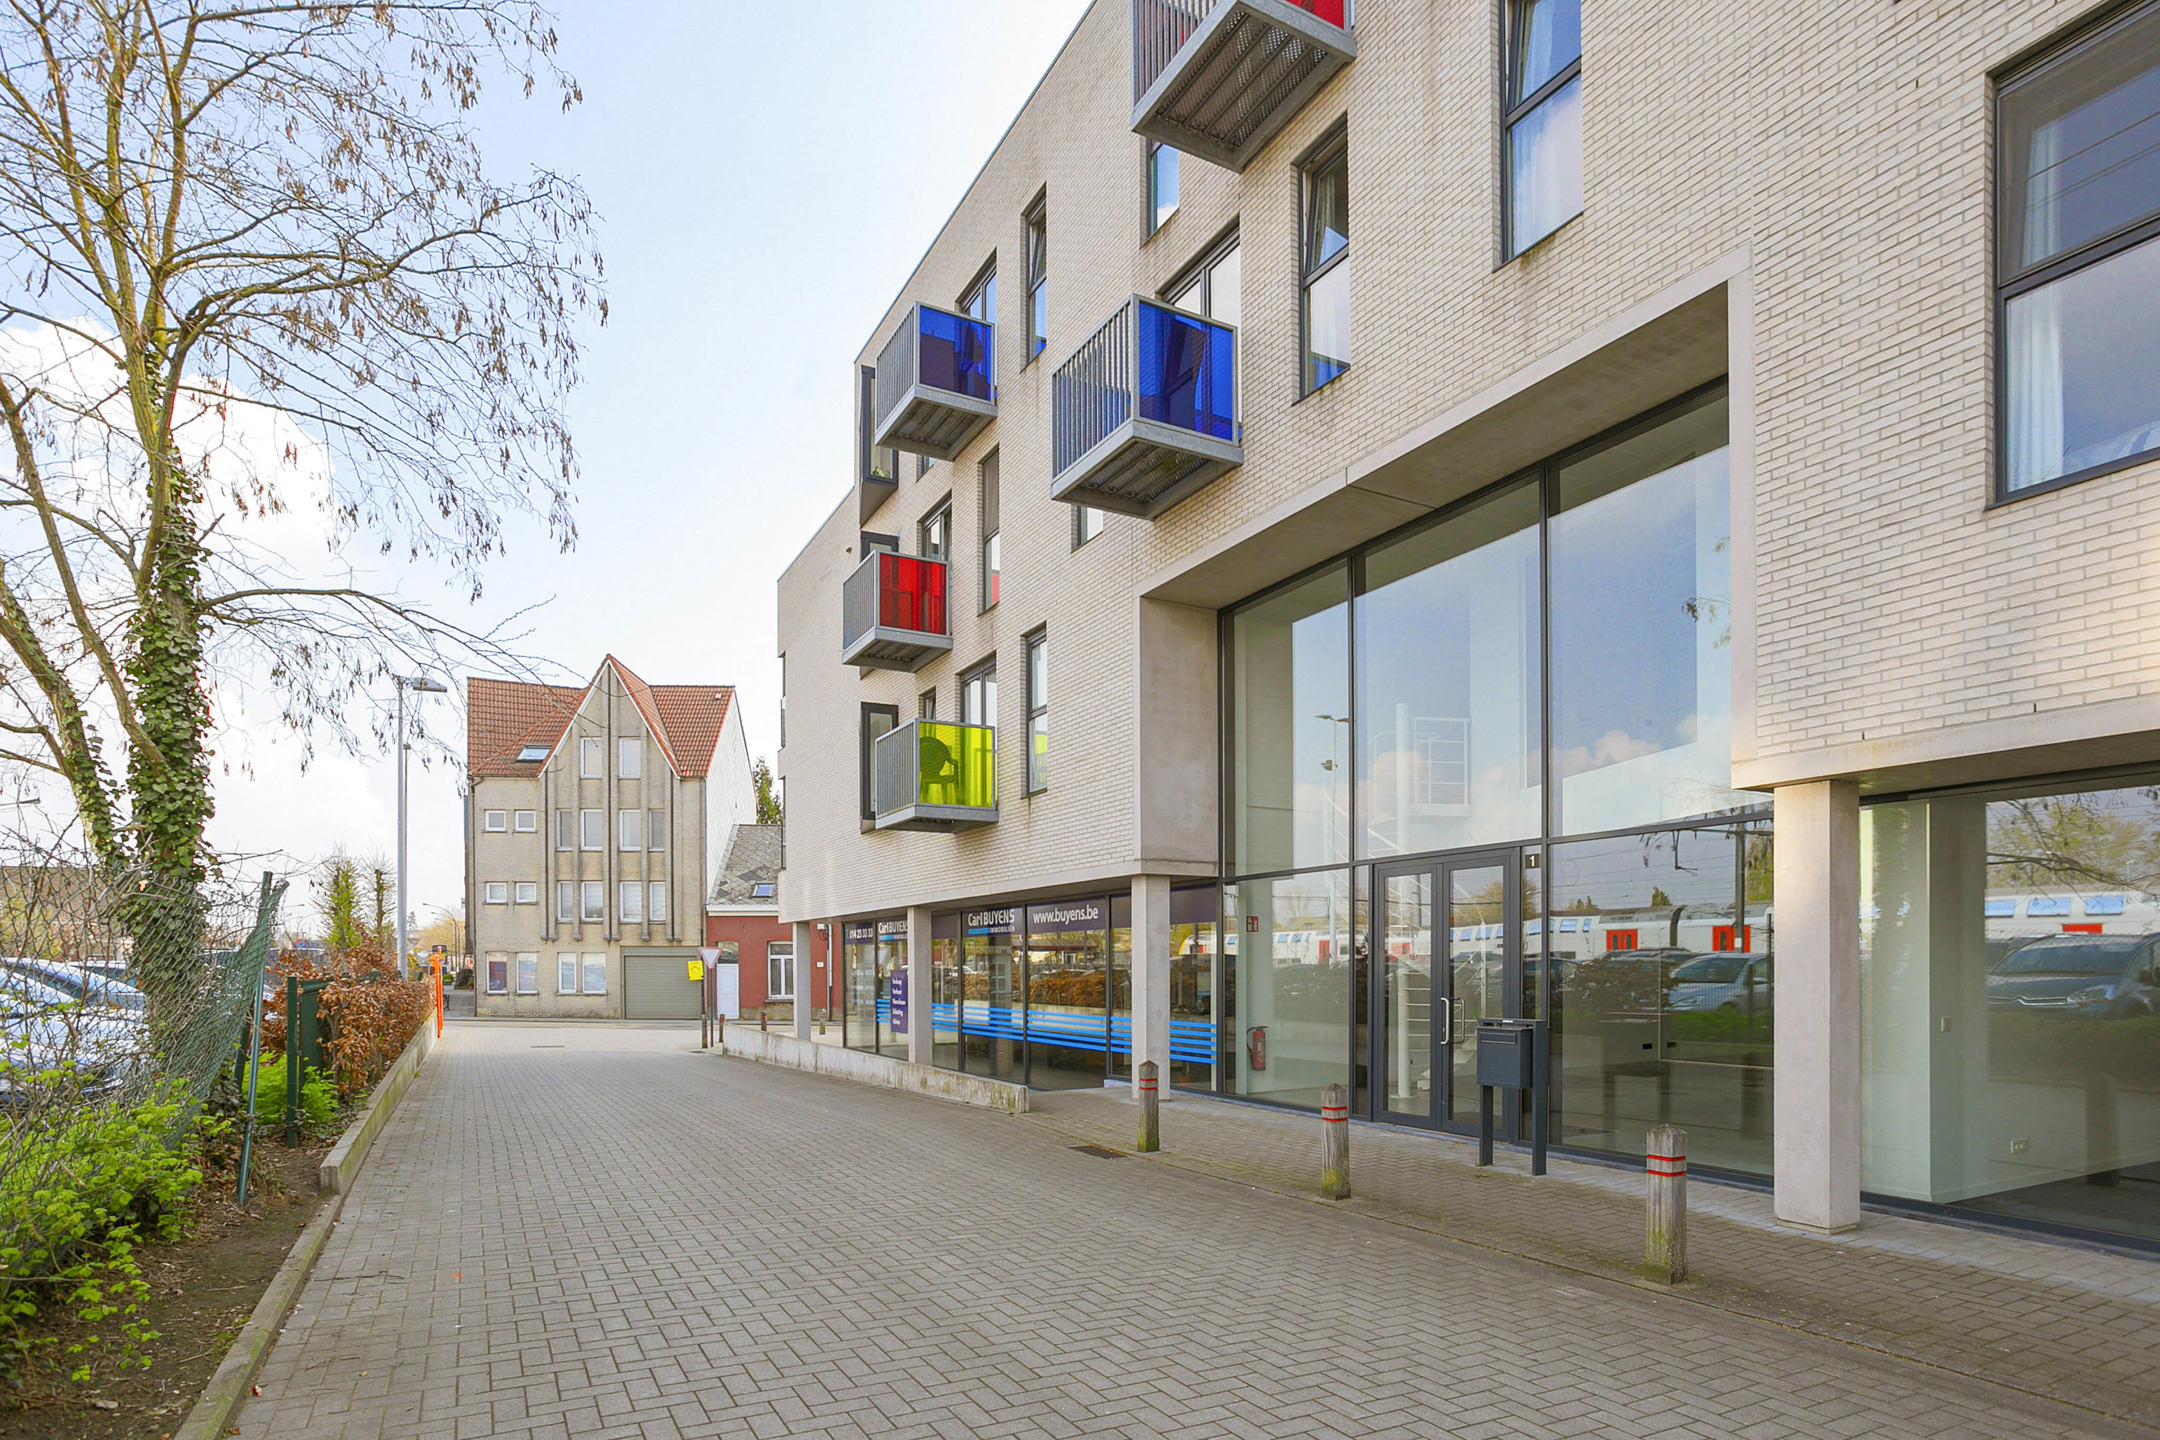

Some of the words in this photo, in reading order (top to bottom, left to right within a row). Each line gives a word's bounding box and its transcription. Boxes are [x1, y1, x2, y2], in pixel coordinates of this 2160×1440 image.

[1530, 855, 1535, 867] 1
[968, 912, 983, 927] Carl
[983, 908, 1015, 926] BUYENS
[1032, 904, 1099, 925] www.buyens.be
[878, 922, 889, 933] Carl
[889, 920, 908, 933] BUYEN
